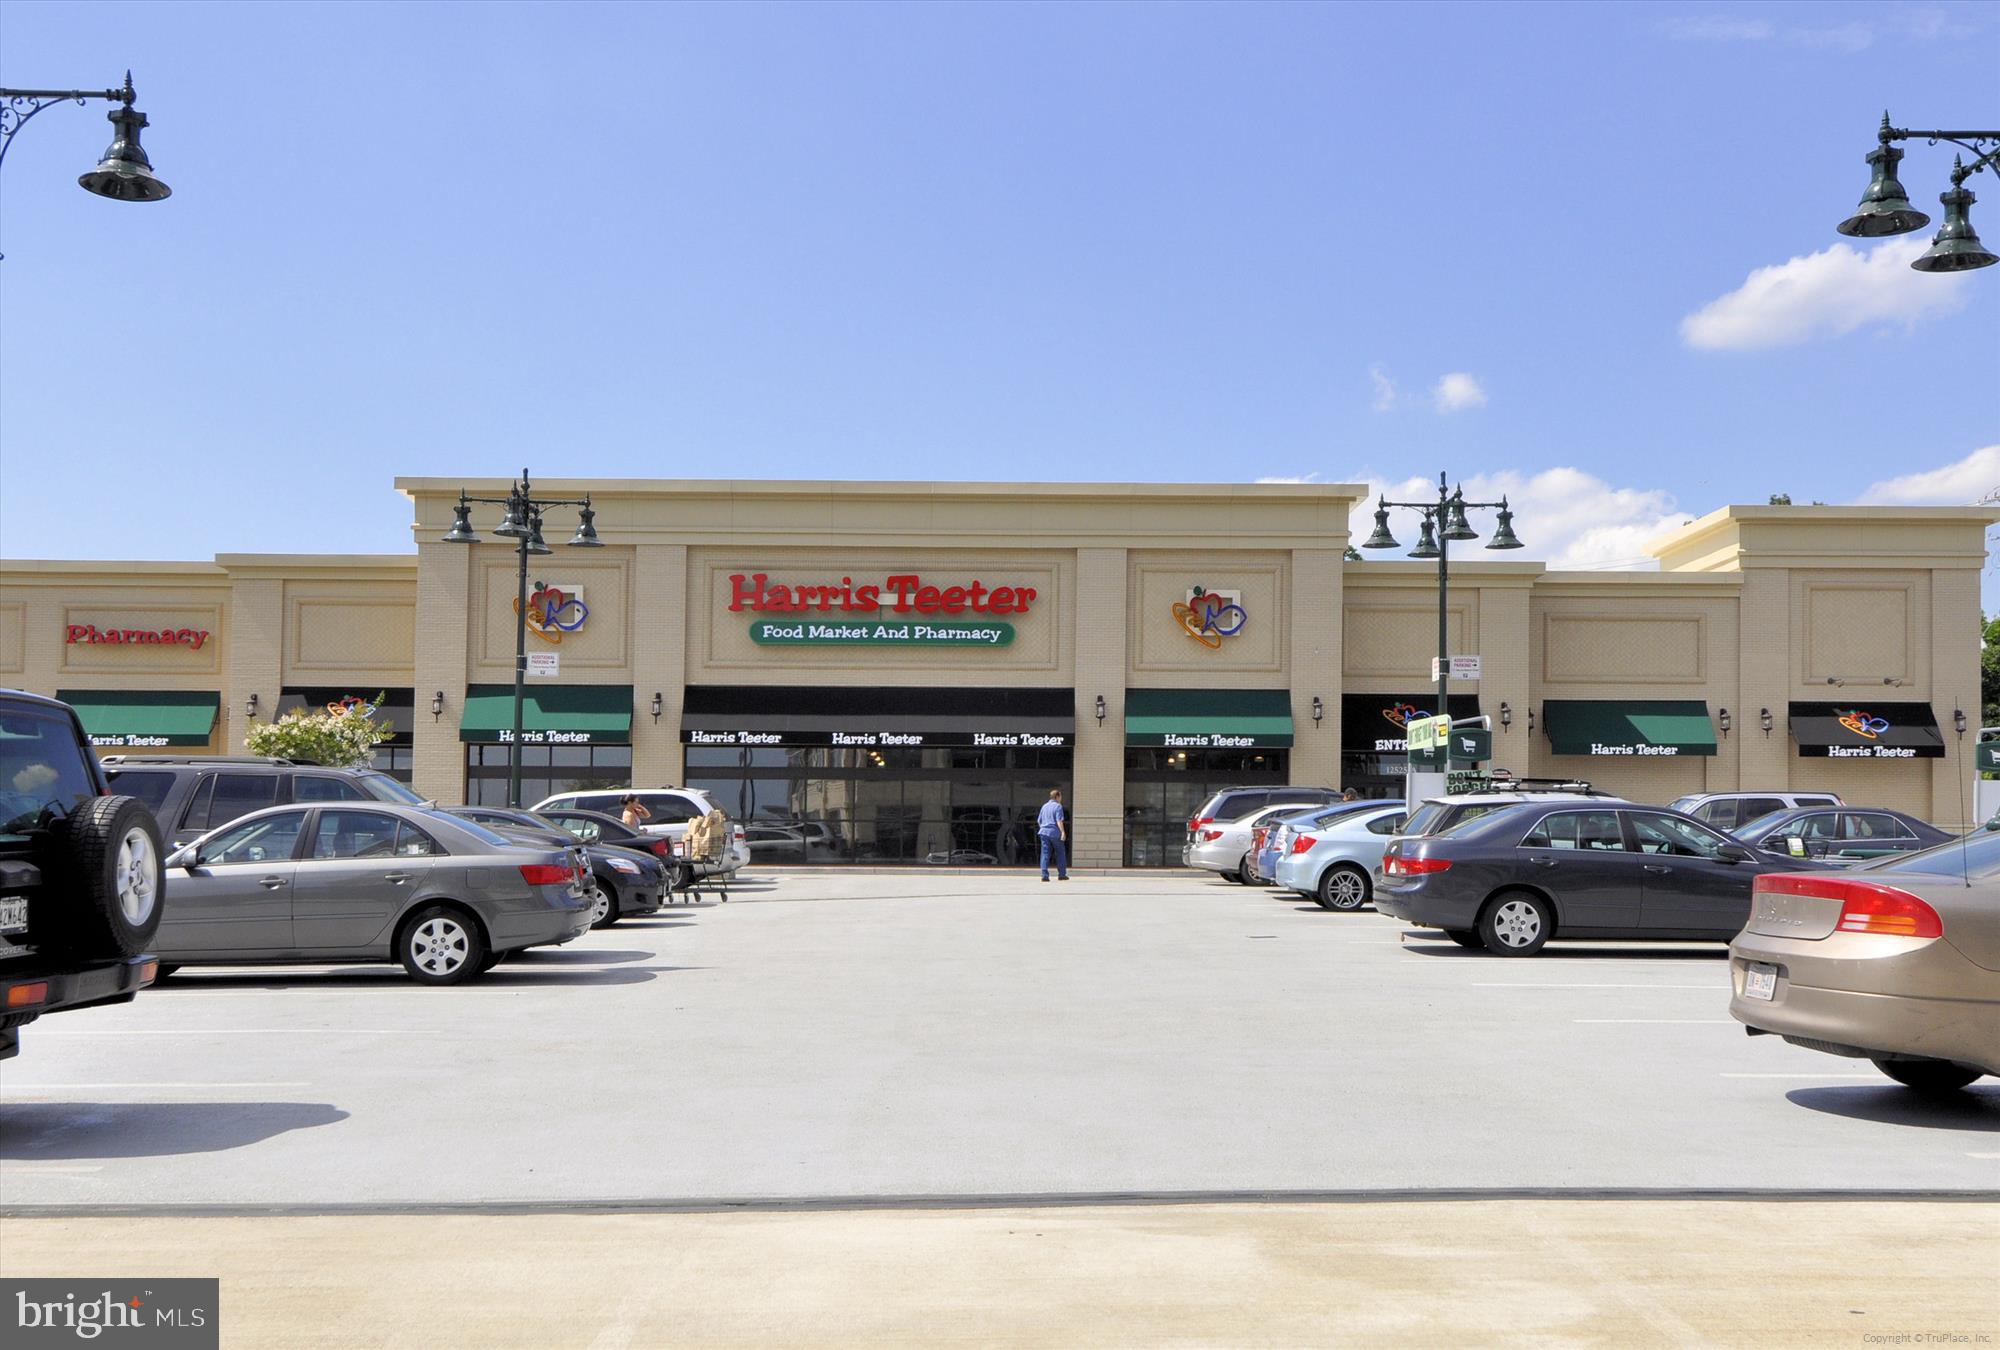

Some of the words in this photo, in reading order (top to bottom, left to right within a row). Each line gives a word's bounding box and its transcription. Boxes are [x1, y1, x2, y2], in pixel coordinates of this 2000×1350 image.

[729, 573, 880, 612] Harris
[886, 574, 1038, 614] Teeter
[66, 624, 209, 650] Pharmacy
[763, 625, 804, 639] Food
[808, 625, 869, 639] Market
[872, 625, 911, 639] And
[914, 625, 1002, 643] Pharmacy
[87, 734, 124, 746] arris
[126, 734, 169, 746] Teeter
[546, 730, 590, 743] Teeter
[691, 730, 736, 743] Harris
[738, 731, 782, 744] Teeter
[832, 732, 876, 745] Harris
[879, 732, 923, 745] Teeter
[973, 733, 1018, 745] Harris
[1020, 733, 1064, 746] Teeter
[1164, 734, 1208, 746] Harris
[1211, 734, 1254, 747] Teeter
[1375, 739, 1408, 751] ENTR
[1591, 743, 1634, 755] Harris
[1636, 743, 1678, 756] Teeter
[1828, 745, 1872, 757] Harris
[1874, 745, 1916, 758] Teeter
[1447, 781, 1489, 796] FORGE
